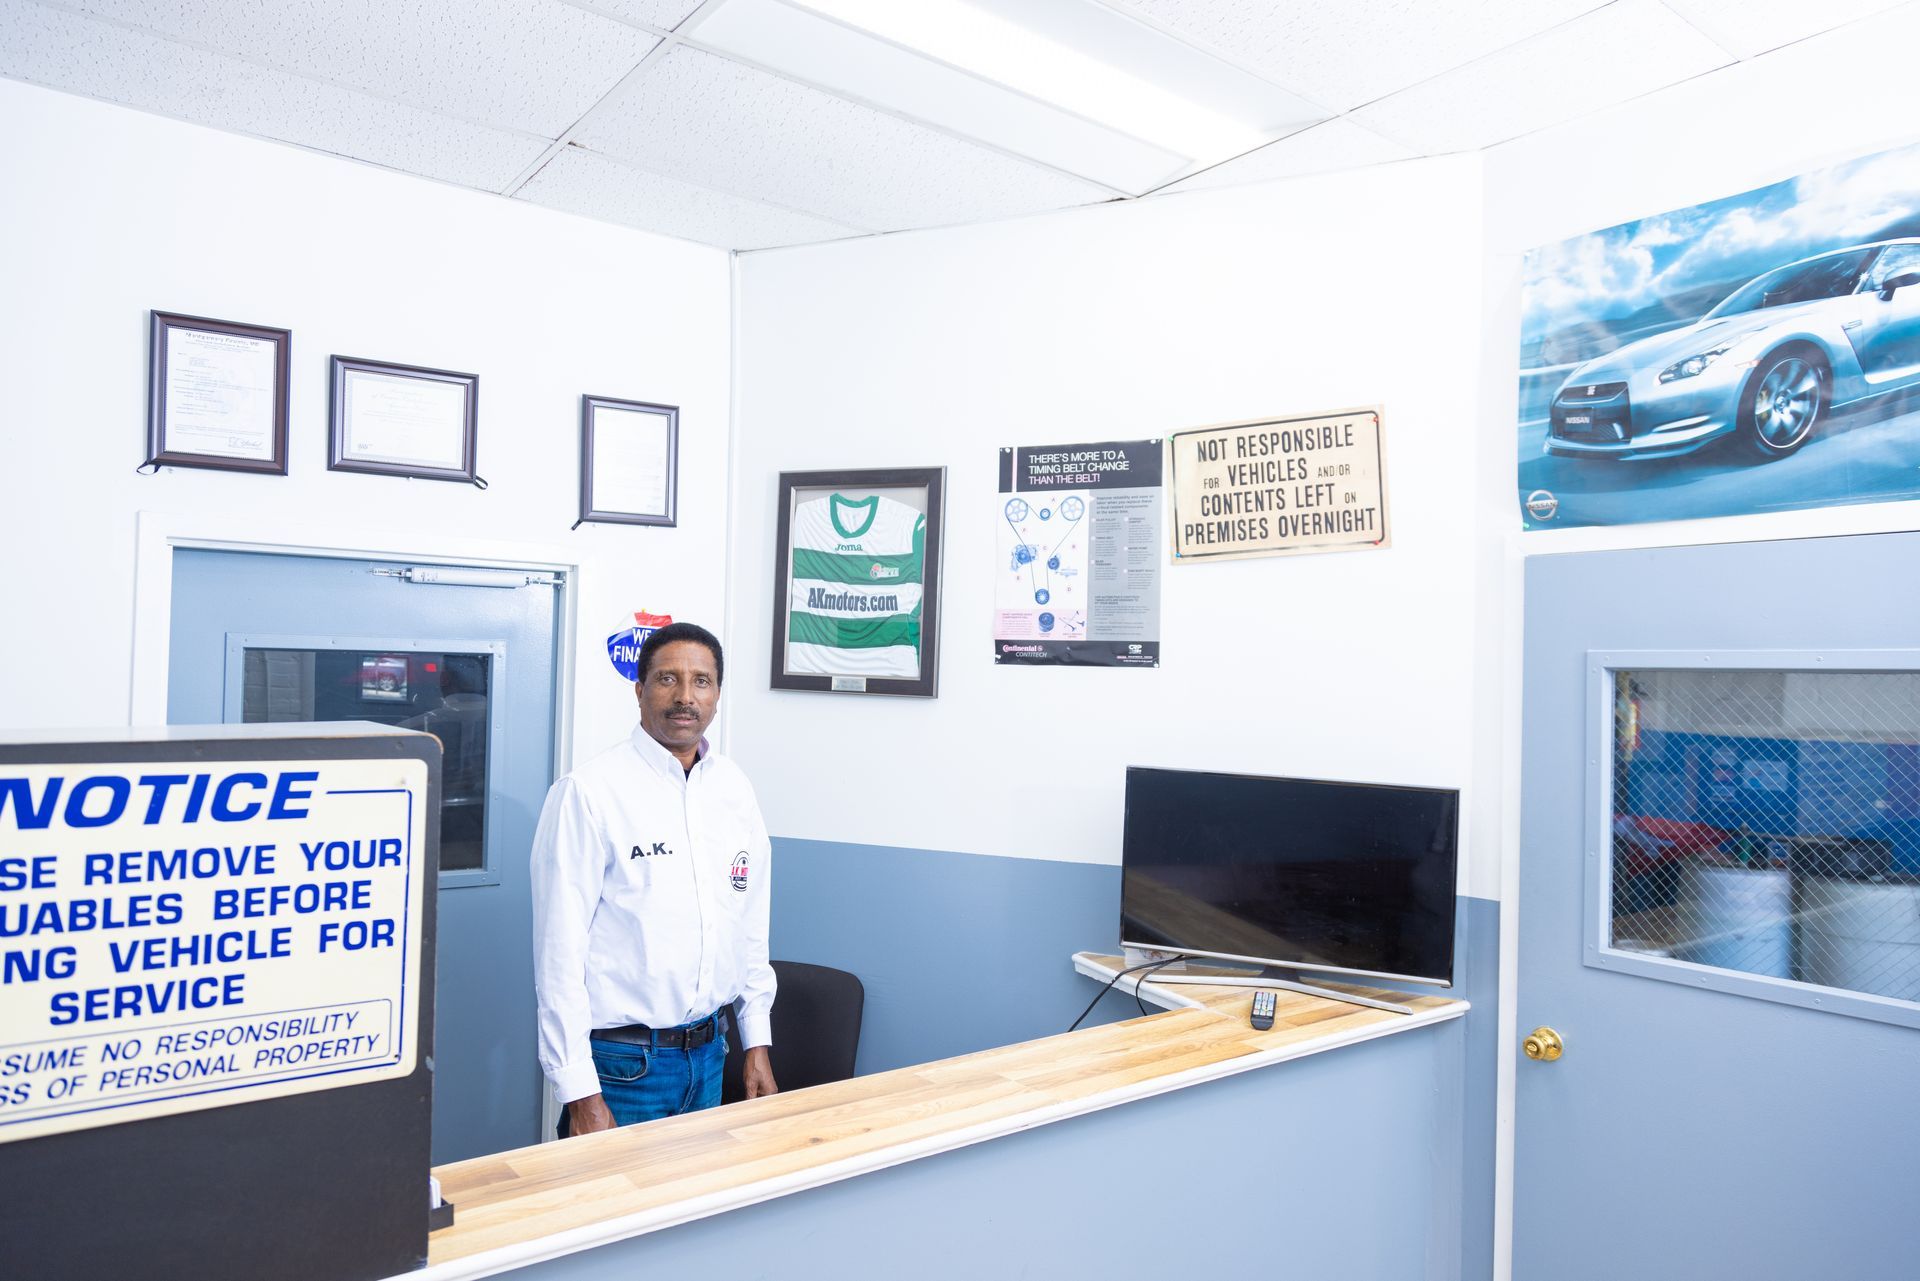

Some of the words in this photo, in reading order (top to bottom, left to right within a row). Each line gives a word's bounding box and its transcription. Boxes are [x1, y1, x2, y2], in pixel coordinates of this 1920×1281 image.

[1566, 416, 1590, 424] NISSAN
[1028, 453, 1069, 464] THERE'S
[1070, 451, 1100, 462] MORE
[1101, 450, 1116, 460] TO
[1117, 450, 1126, 460] A
[1197, 438, 1228, 463] NOT
[1237, 424, 1354, 458] RESPONSIBLE
[1028, 465, 1061, 475] TIMING
[1062, 463, 1086, 473] BELT
[1087, 461, 1130, 472] CHANGE
[1028, 475, 1054, 485] THAN
[1055, 474, 1074, 484] THE
[1075, 473, 1101, 483] BELT!
[1203, 477, 1220, 489] FOR
[1228, 457, 1308, 487] VEHICLES
[1201, 488, 1286, 517] CONTENTS
[1295, 483, 1335, 508] LEFT
[1344, 491, 1357, 504] ON
[1185, 516, 1269, 545] PREMISES
[1278, 507, 1376, 538] OVERNIGHT
[807, 588, 899, 612] AKmotors.com
[0, 772, 319, 830] NOTICE
[0, 856, 58, 892] SE
[84, 844, 277, 886] REMOVE
[300, 838, 402, 872] YOUR
[630, 842, 673, 860] A.K.
[212, 880, 372, 921] BEFORE
[3, 946, 77, 984] NG
[109, 927, 292, 973] VEHICLE
[318, 918, 395, 954] FOR
[49, 974, 246, 1027] SERVICE
[100, 1039, 142, 1063] NO
[155, 1010, 360, 1055] RESPONSIBILITY
[47, 1074, 88, 1100] OF
[99, 1049, 241, 1092] PERSONAL
[253, 1033, 381, 1070] PROPERTY
